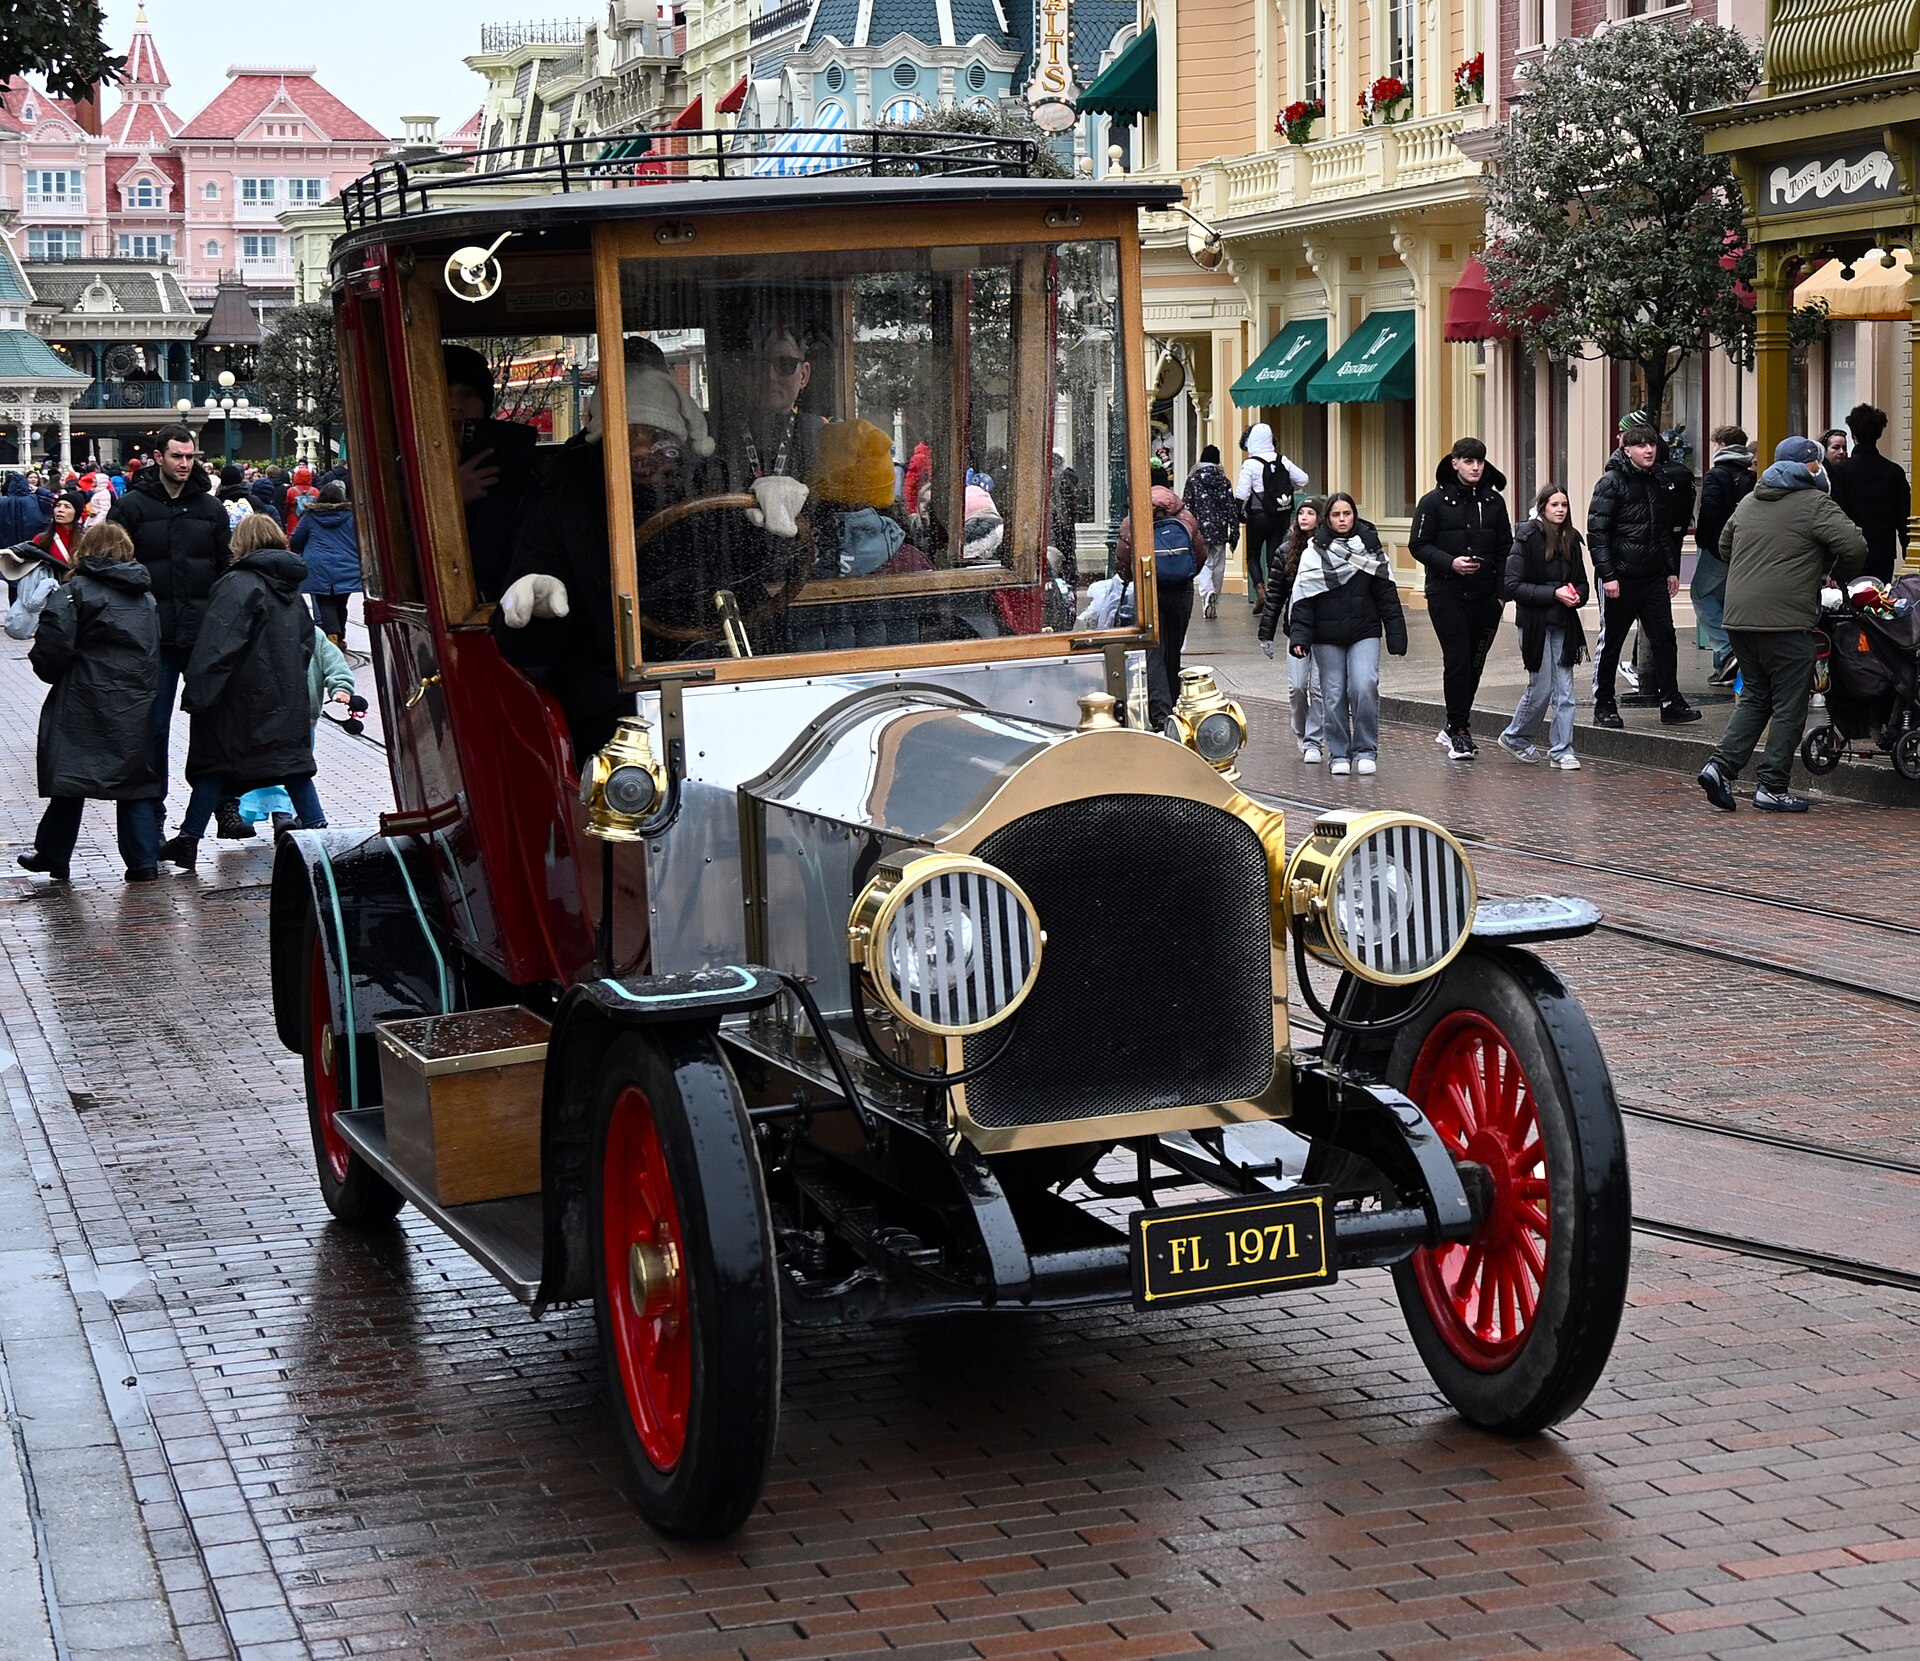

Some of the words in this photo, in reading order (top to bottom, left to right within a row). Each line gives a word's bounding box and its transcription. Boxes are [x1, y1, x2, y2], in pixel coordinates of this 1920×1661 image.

[1789, 169, 1815, 198] TOYS
[1821, 168, 1840, 191] AND
[1844, 160, 1874, 190] DOLLS
[1168, 1236, 1209, 1274] FL
[1225, 1223, 1299, 1267] 1971
